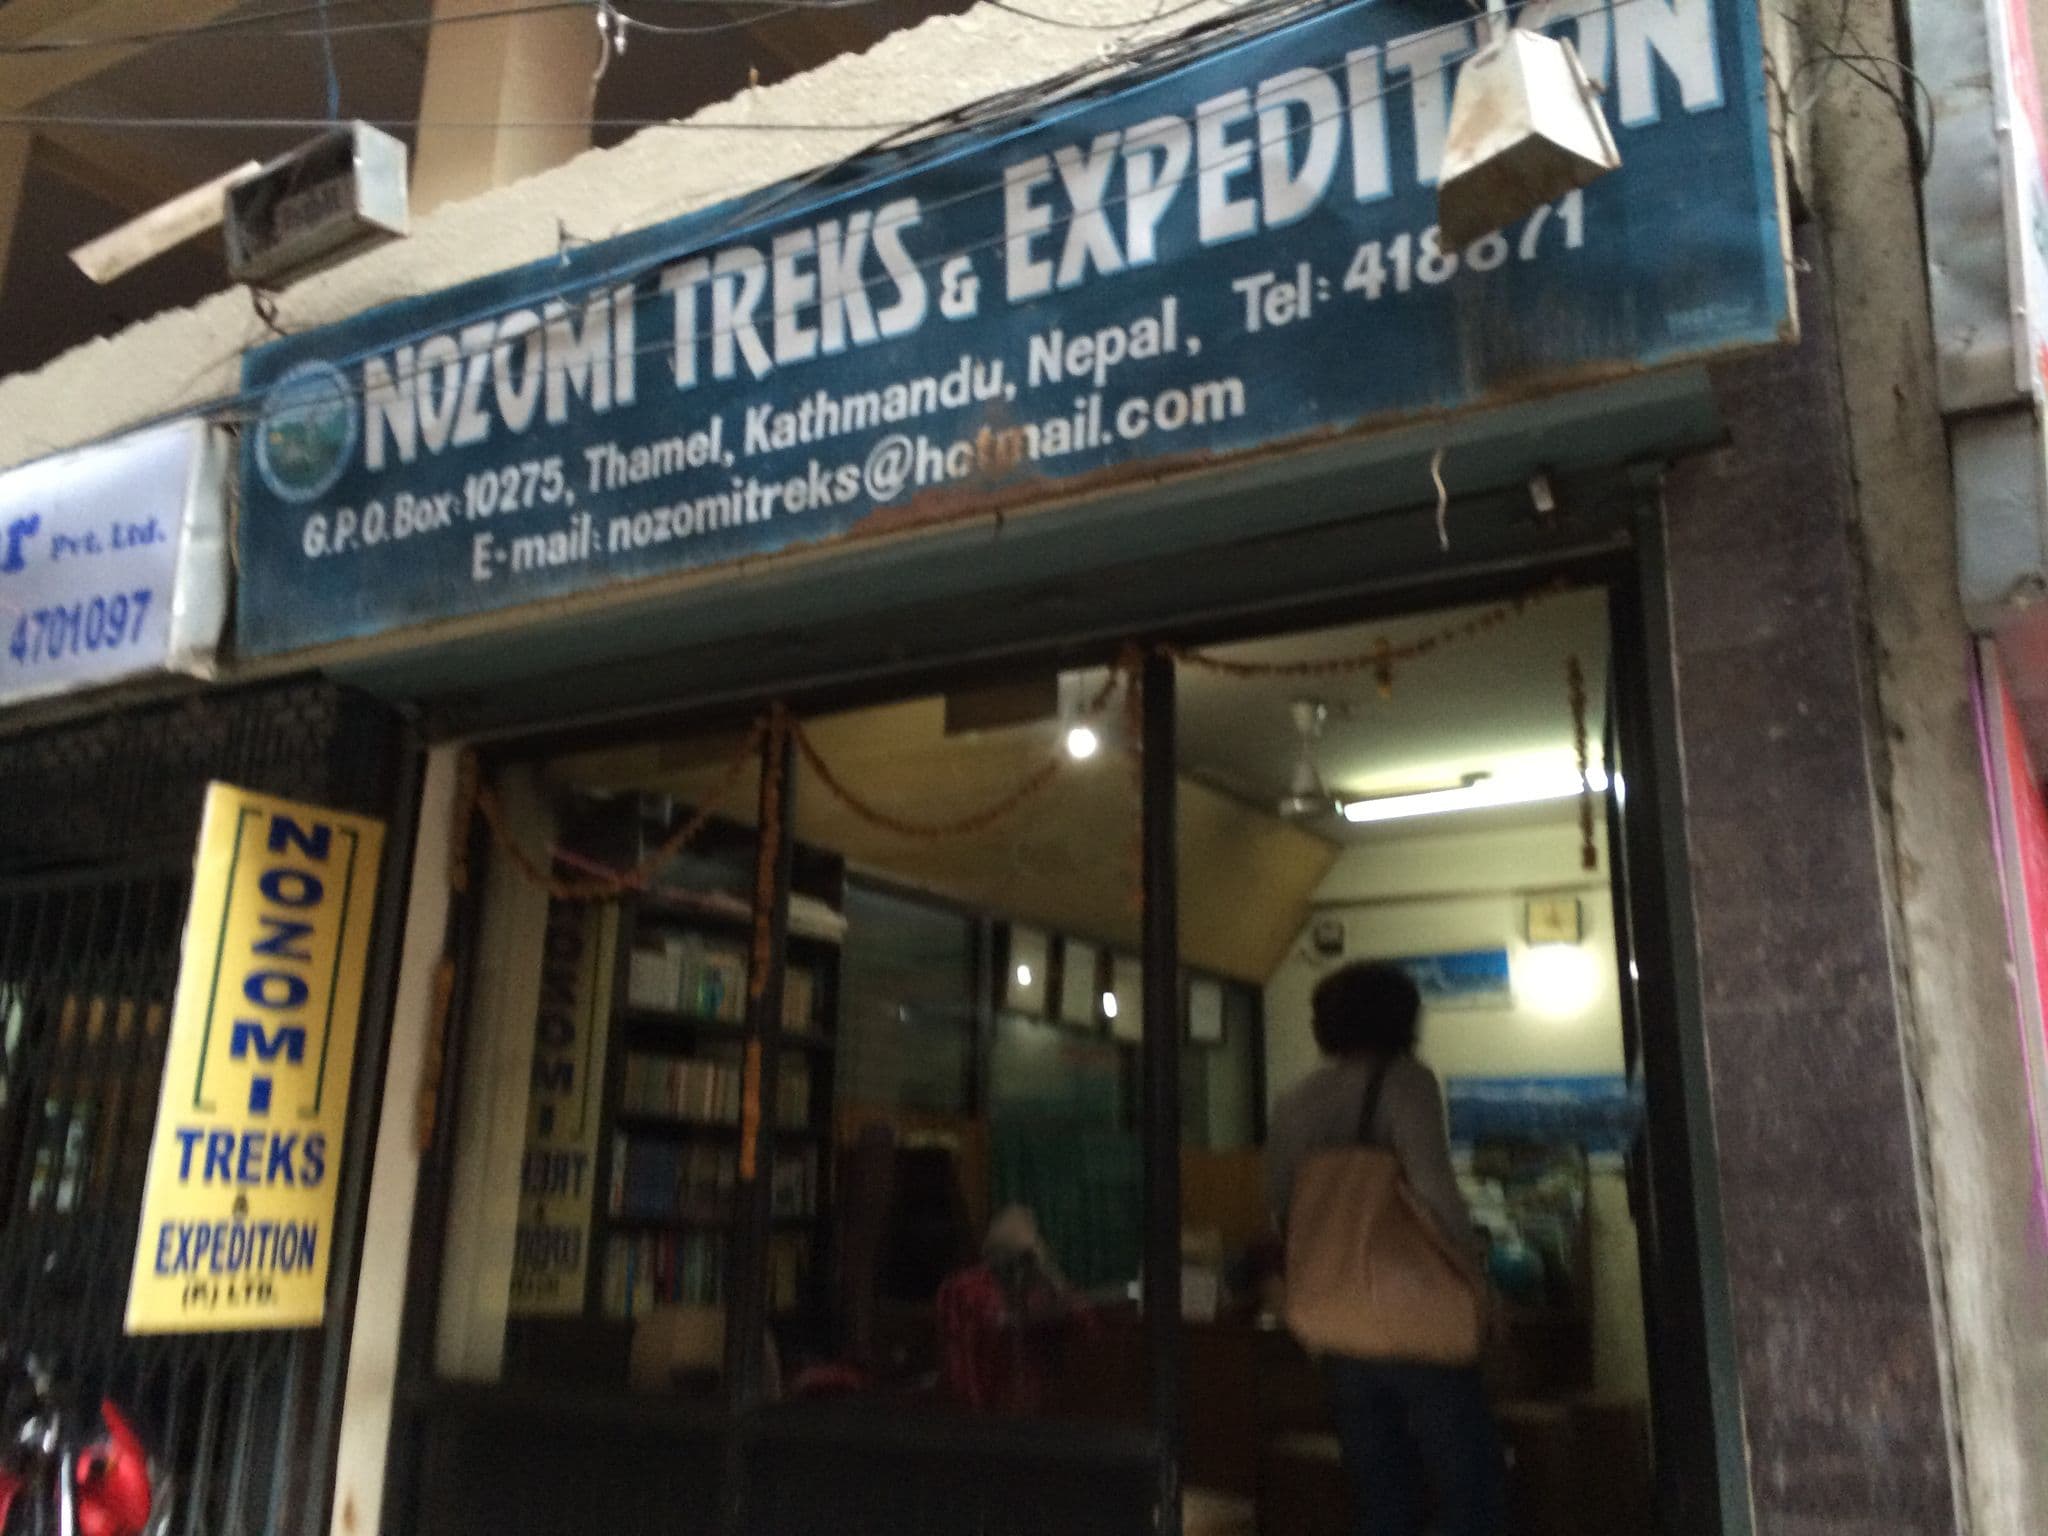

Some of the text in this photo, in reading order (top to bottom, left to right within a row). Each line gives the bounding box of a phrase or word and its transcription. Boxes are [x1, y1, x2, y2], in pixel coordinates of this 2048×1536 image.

[363, 283, 636, 472] NOZOMI
[660, 197, 928, 391] TREKS
[939, 256, 981, 321] &
[584, 415, 735, 492] Thamel,
[744, 355, 1016, 456] Kathmandu,
[1028, 296, 1202, 387] Nepal,
[1232, 262, 1329, 333] Tel:
[229, 813, 332, 1118] NOZOMI
[155, 1220, 318, 1278] EXPEDITION
[176, 1128, 327, 1187] TREKS
